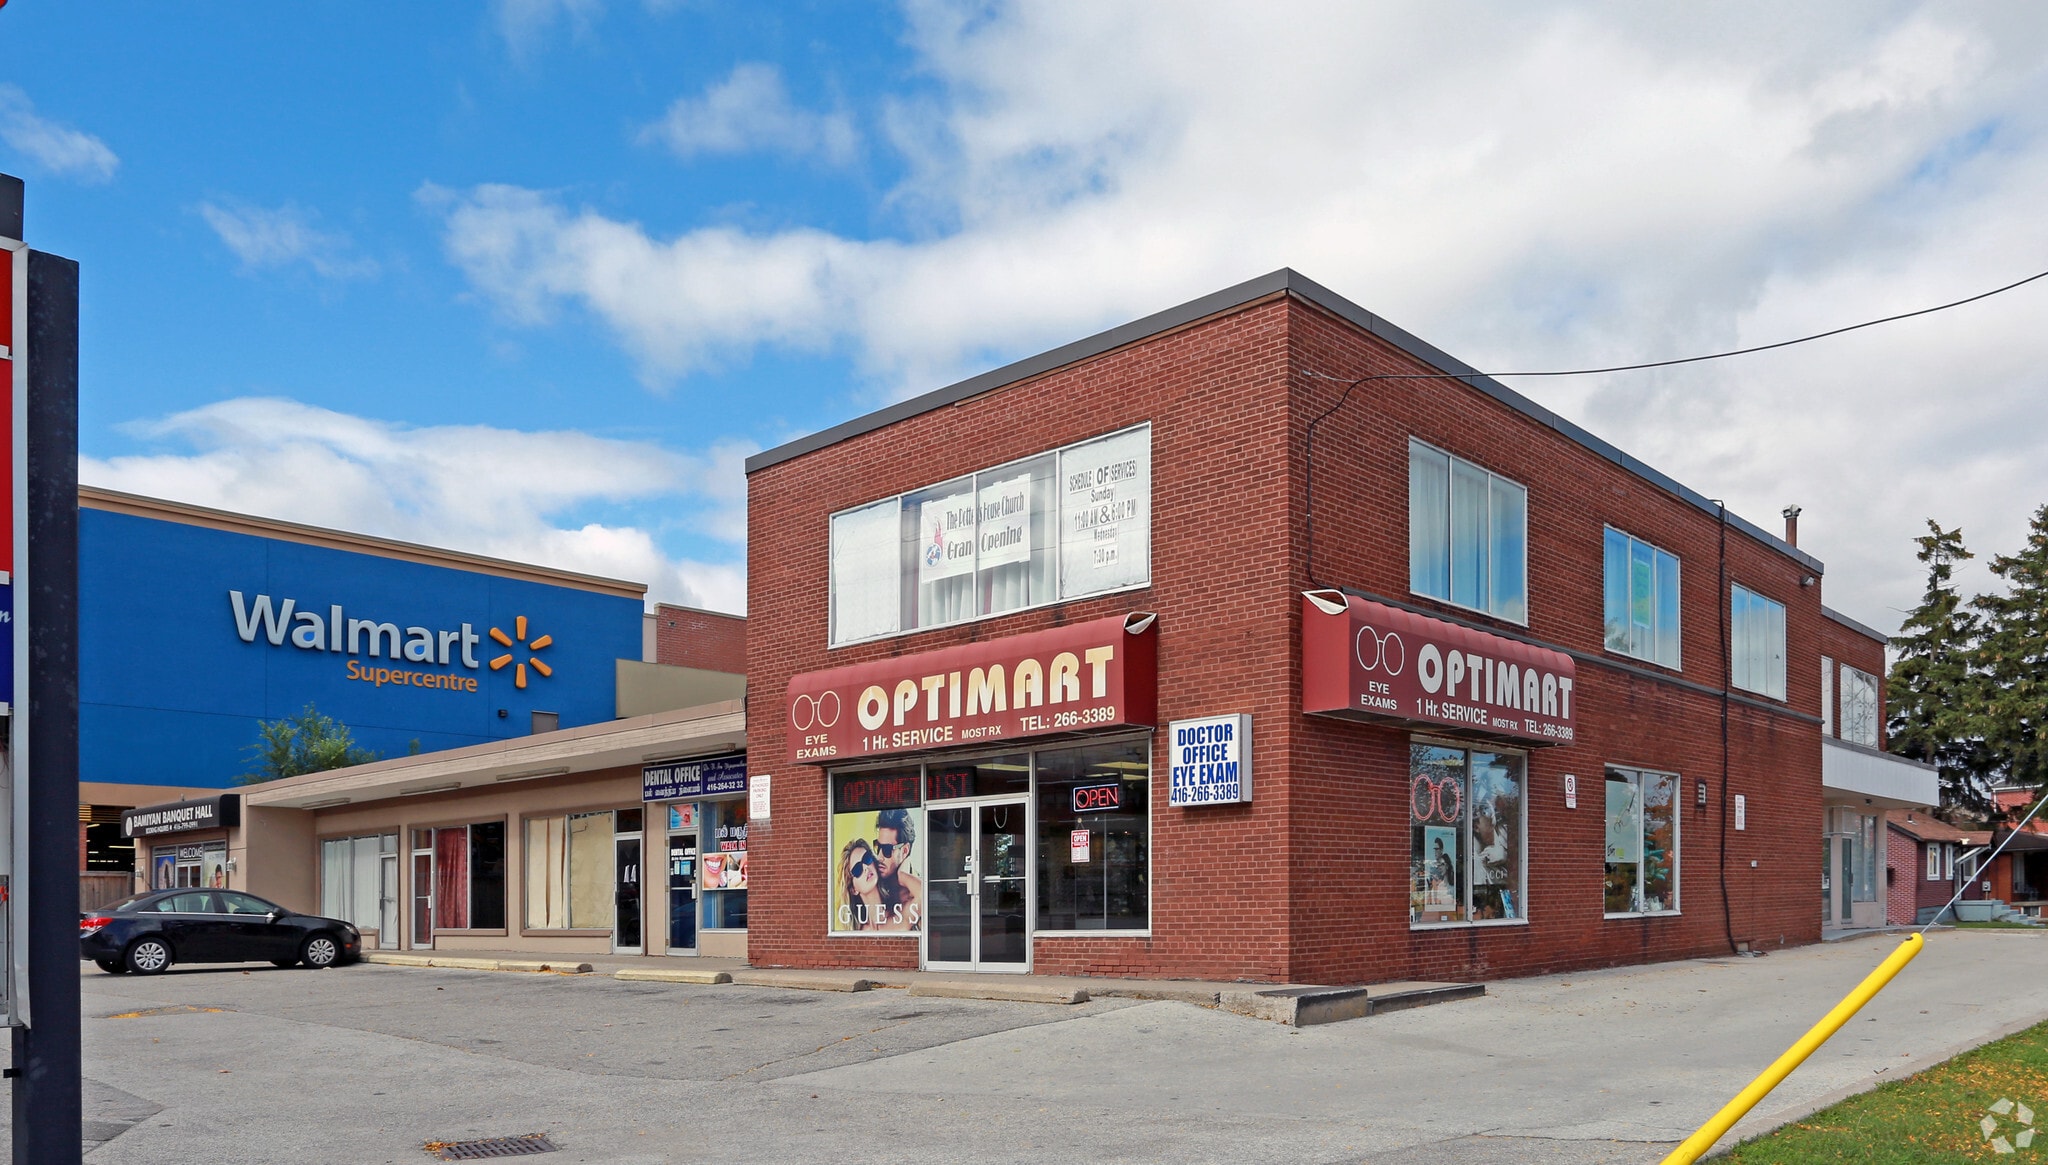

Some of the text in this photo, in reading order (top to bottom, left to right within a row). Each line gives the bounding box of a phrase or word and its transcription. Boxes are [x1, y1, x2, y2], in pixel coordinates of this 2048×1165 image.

[1070, 460, 1136, 492] SCHEDULE OF SERVICES
[1091, 486, 1114, 502] Sunday
[946, 511, 958, 530] The
[984, 502, 1000, 521] House
[1002, 492, 1024, 516] Church
[1100, 506, 1110, 523] &
[1127, 499, 1136, 517] PM
[981, 526, 1022, 552] Opening
[1094, 528, 1117, 540] Wednesday
[229, 590, 479, 668] Walmart
[346, 660, 478, 692] Supercentre
[1417, 643, 1573, 720] OPTIMART
[857, 645, 1114, 731] OPTIMART
[1368, 681, 1390, 695] EYE
[1360, 694, 1397, 711] EXAMS
[862, 706, 1116, 751] 1 Hr. SERVICE MOST RX TEL: 266-3389
[1416, 698, 1573, 740] 1 Hr. SERVICE MOST RX TEL: 266-3389
[805, 734, 828, 746] EYE
[1178, 724, 1233, 746] DOCTOR
[796, 746, 837, 759] EXAMS
[1183, 743, 1228, 764] OFFICE
[644, 768, 672, 786] DENTAL
[674, 765, 700, 784] OFFICE
[736, 780, 744, 788] 32
[1173, 761, 1238, 787] EYE EXAM
[1076, 786, 1119, 808] OPEN
[1171, 784, 1238, 803] 416-266-3389
[134, 804, 213, 828] BAMIYAN BANQUET HALL
[180, 847, 202, 858] WELCOME
[684, 848, 696, 856] OFFICE
[720, 840, 746, 852] WALK IN
[838, 903, 919, 924] GUESS
